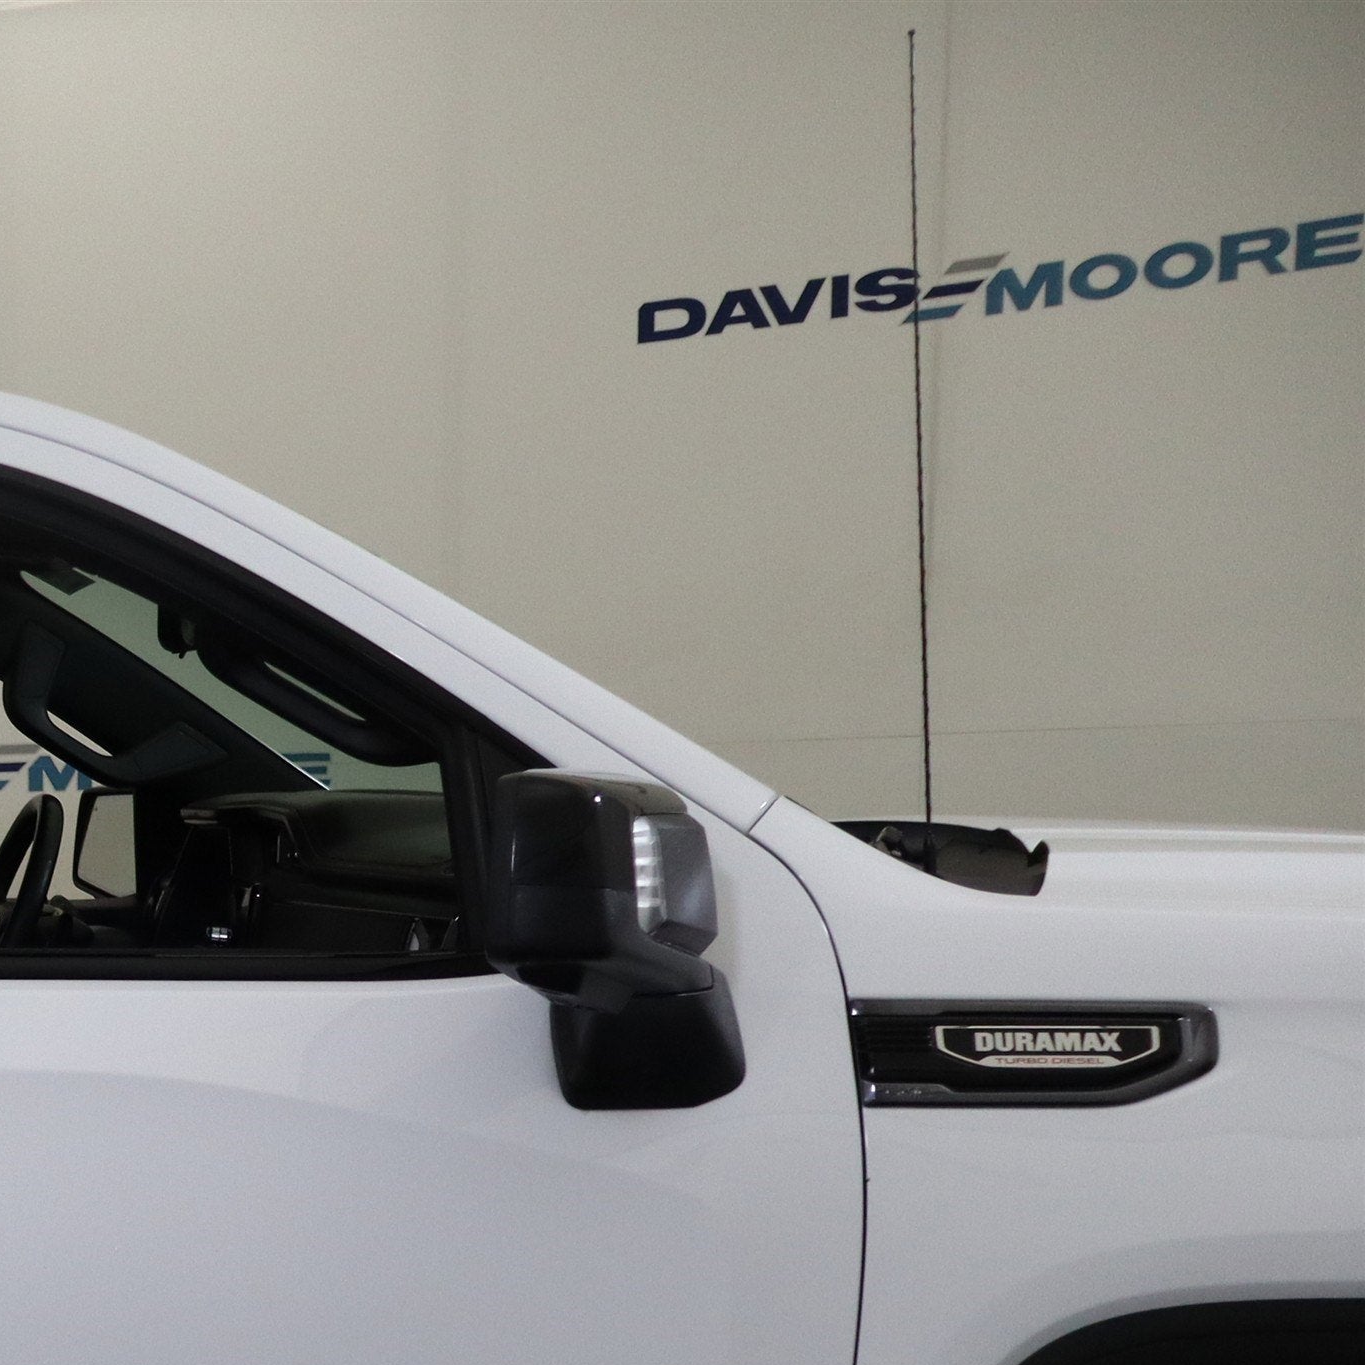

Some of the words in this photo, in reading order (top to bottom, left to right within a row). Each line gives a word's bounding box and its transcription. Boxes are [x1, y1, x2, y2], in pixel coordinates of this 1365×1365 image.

[636, 267, 921, 345] DAVIS
[983, 213, 1365, 315] MOORE
[974, 1031, 1122, 1052] DURAMAX
[995, 1056, 1048, 1065] TURBO
[1051, 1056, 1105, 1065] DIESEL
